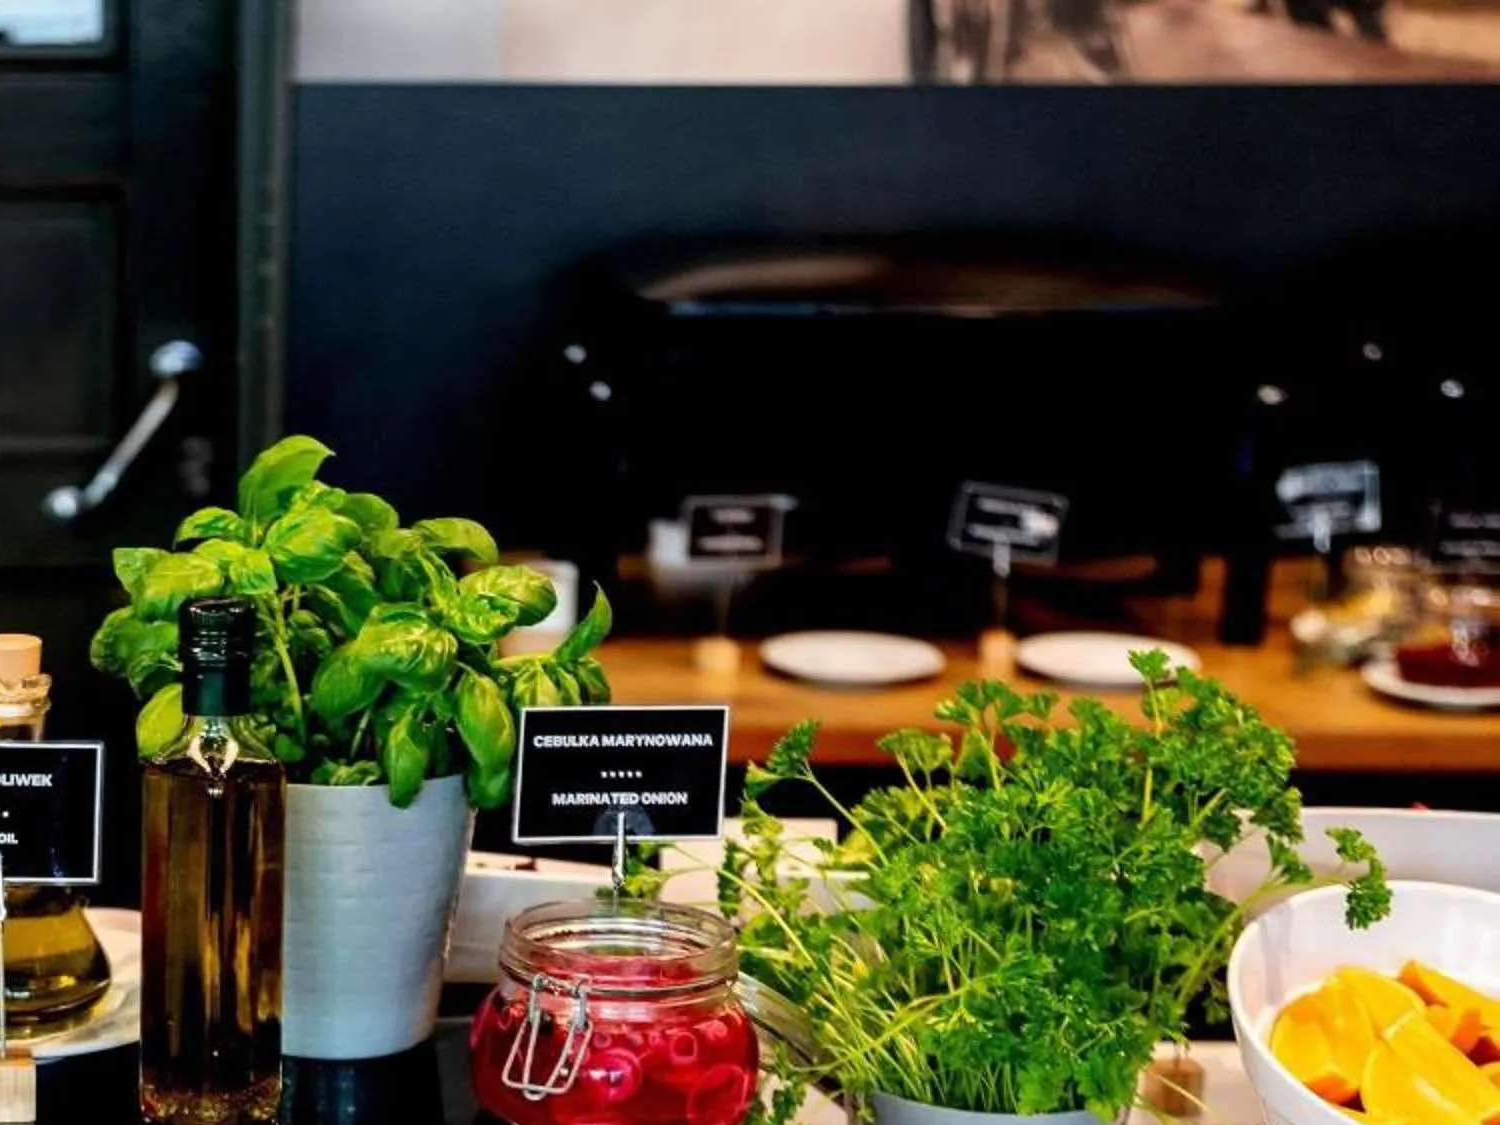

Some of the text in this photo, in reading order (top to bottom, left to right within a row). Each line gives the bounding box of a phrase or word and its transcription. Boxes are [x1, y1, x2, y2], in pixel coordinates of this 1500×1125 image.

[533, 733, 713, 748] CEBULKA MARYNOWANA
[552, 792, 688, 805] MARINATED ONION
